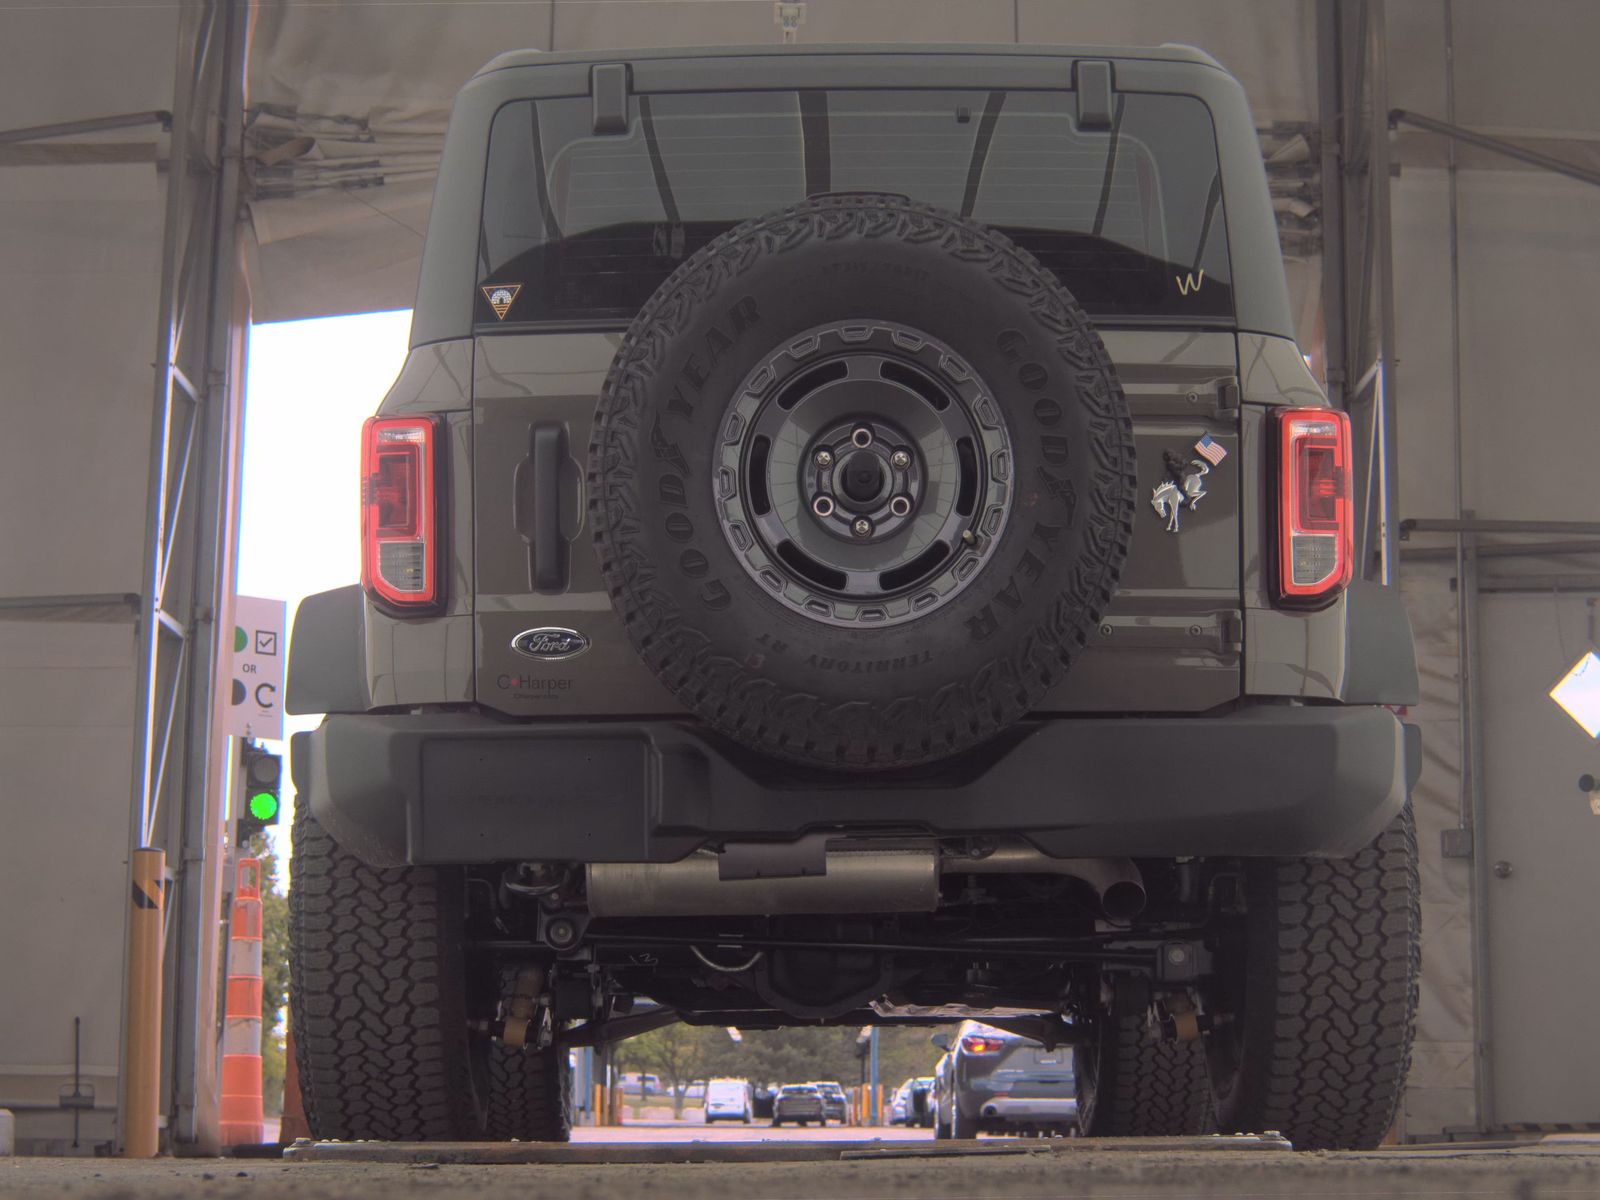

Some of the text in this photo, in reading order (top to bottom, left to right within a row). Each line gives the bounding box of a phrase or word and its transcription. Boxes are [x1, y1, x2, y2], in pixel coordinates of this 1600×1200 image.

[1175, 268, 1205, 296] W
[528, 633, 571, 653] Ford
[755, 632, 935, 674] TERRITORY RT
[242, 663, 257, 674] OR
